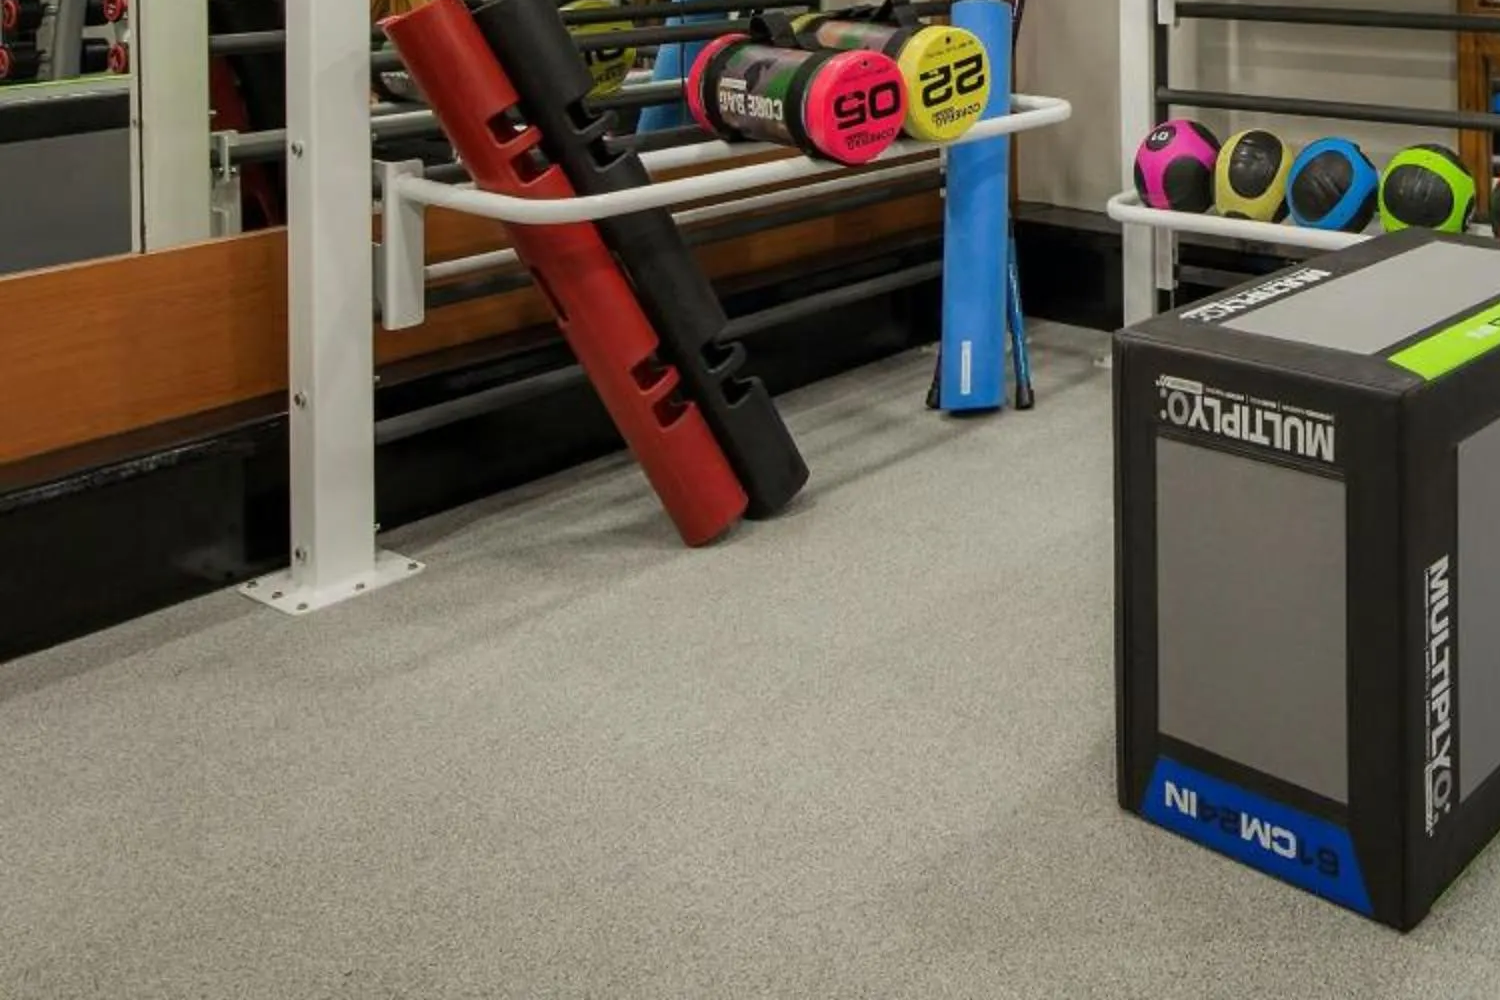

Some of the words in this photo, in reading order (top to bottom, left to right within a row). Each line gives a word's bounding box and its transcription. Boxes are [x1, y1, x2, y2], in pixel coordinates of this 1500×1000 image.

[719, 90, 745, 115] BAG
[833, 80, 899, 131] 05
[919, 53, 985, 108] 22
[747, 94, 784, 121] CORE
[1166, 391, 1336, 462] MULTIPLYO
[1430, 554, 1452, 808] MULTIPLYO
